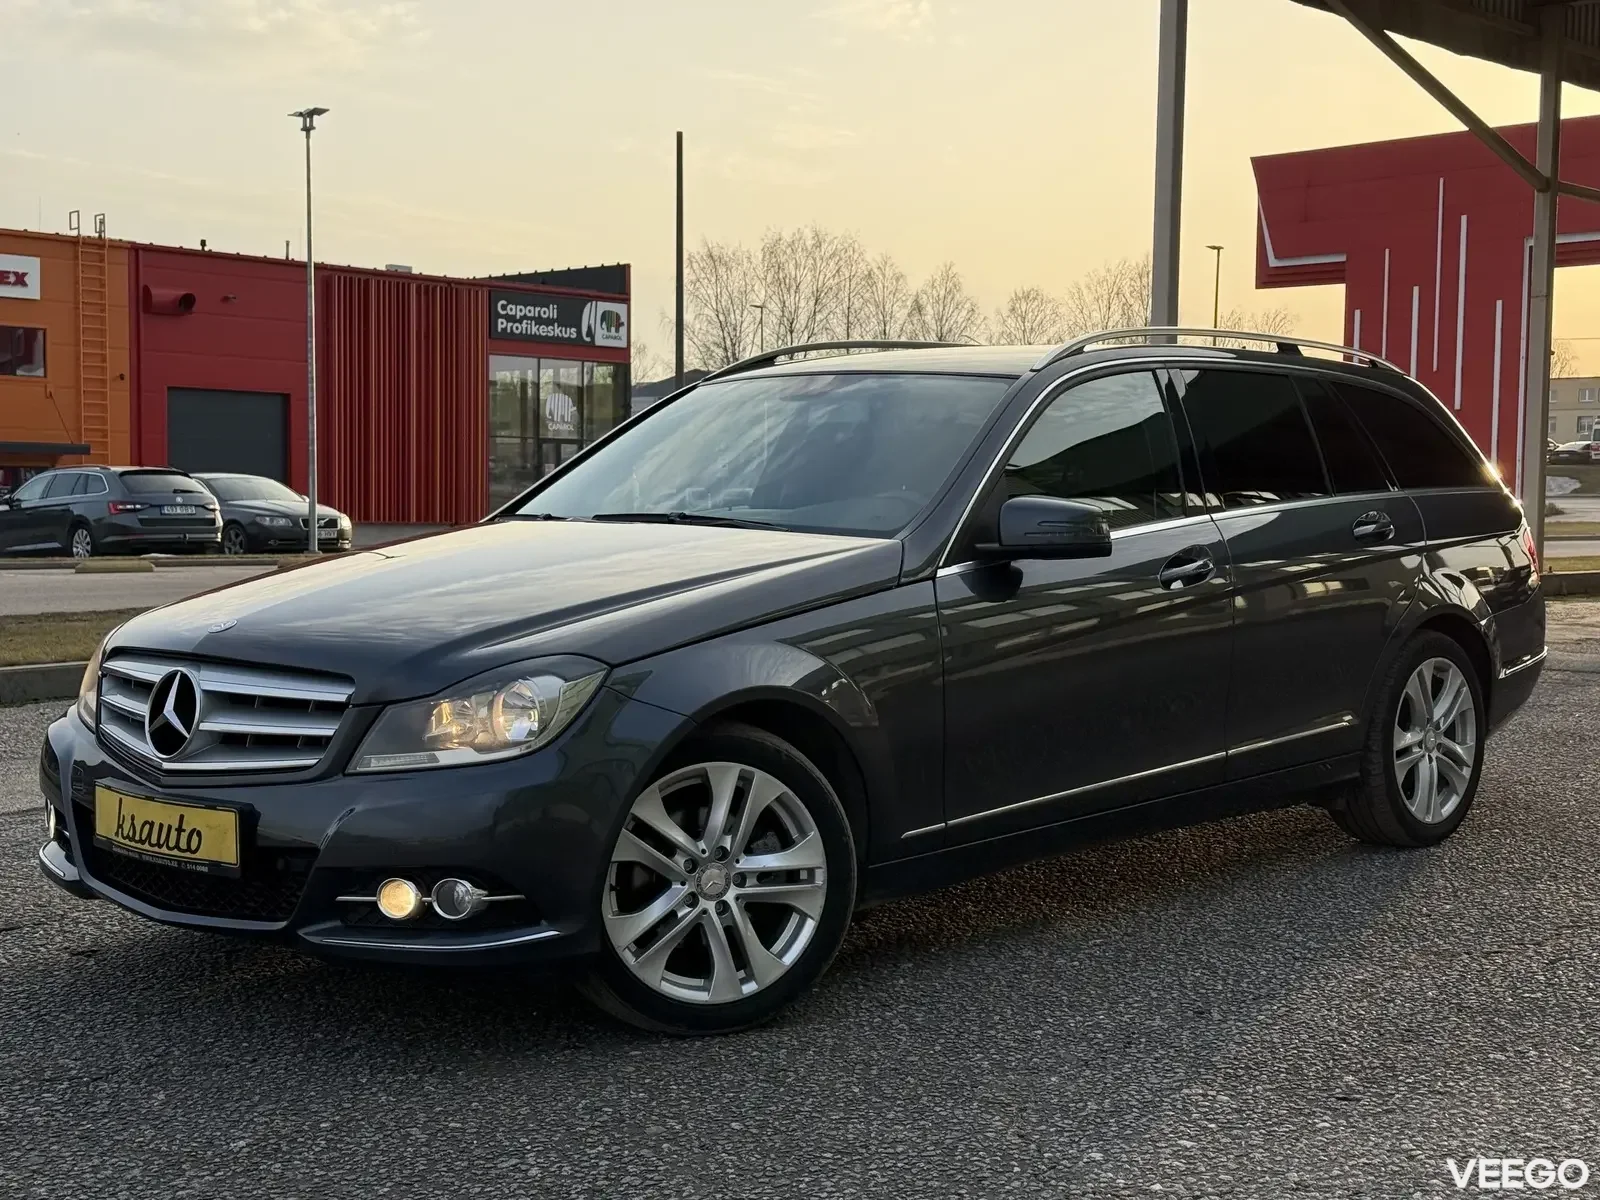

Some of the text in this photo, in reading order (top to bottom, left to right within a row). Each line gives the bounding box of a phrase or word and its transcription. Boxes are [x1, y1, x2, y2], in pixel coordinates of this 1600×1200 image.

[0, 270, 29, 287] EX
[497, 300, 558, 319] Caparoli
[497, 318, 578, 339] Profikeskus
[548, 422, 574, 431] CAPAROL
[114, 797, 203, 855] ksauto
